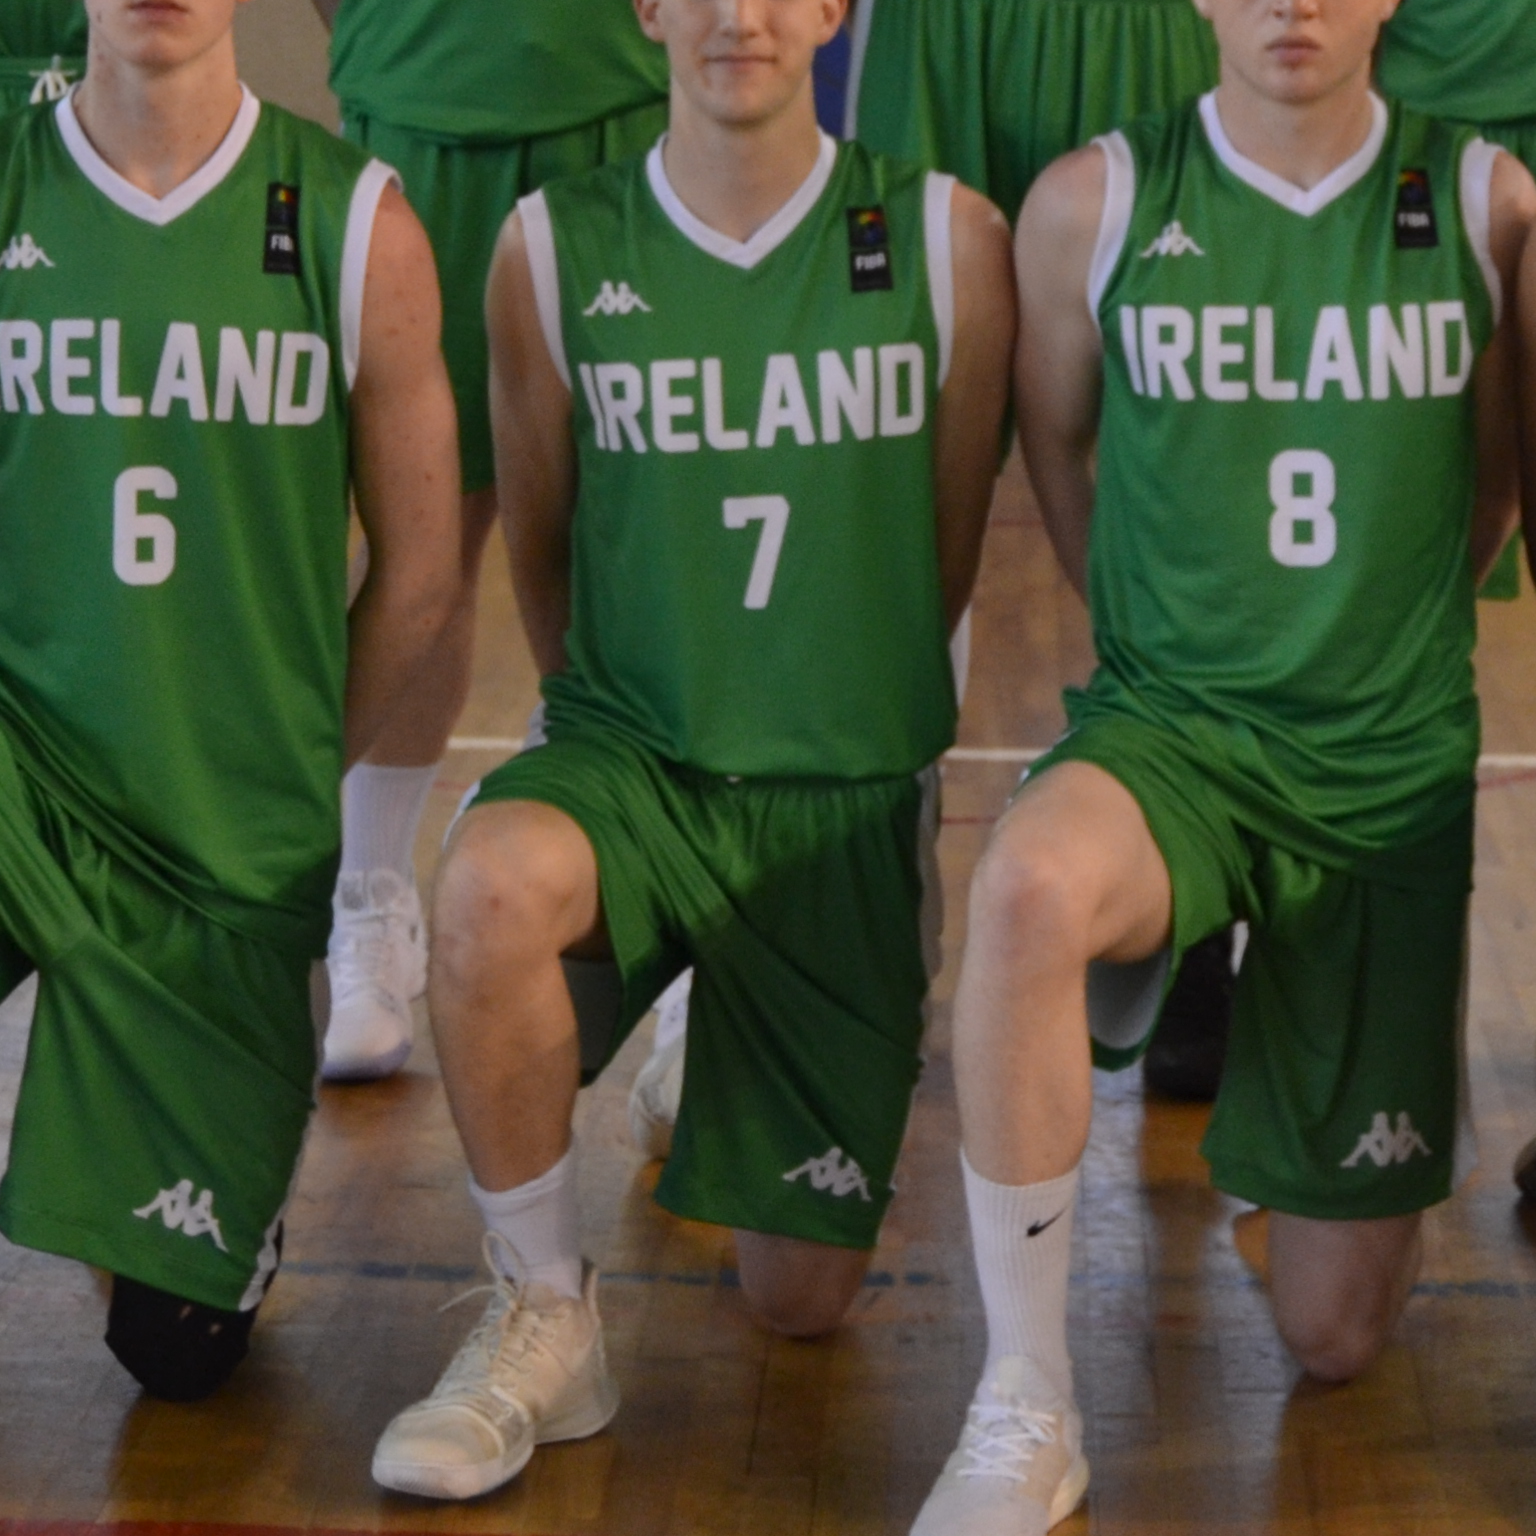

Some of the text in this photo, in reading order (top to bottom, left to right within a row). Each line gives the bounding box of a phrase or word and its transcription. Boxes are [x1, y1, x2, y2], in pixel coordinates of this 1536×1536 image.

[578, 341, 926, 454] IRELAND
[1119, 299, 1474, 402] IRELAND
[112, 465, 178, 586] 6
[722, 494, 791, 611] 7
[1269, 448, 1337, 567] 8
